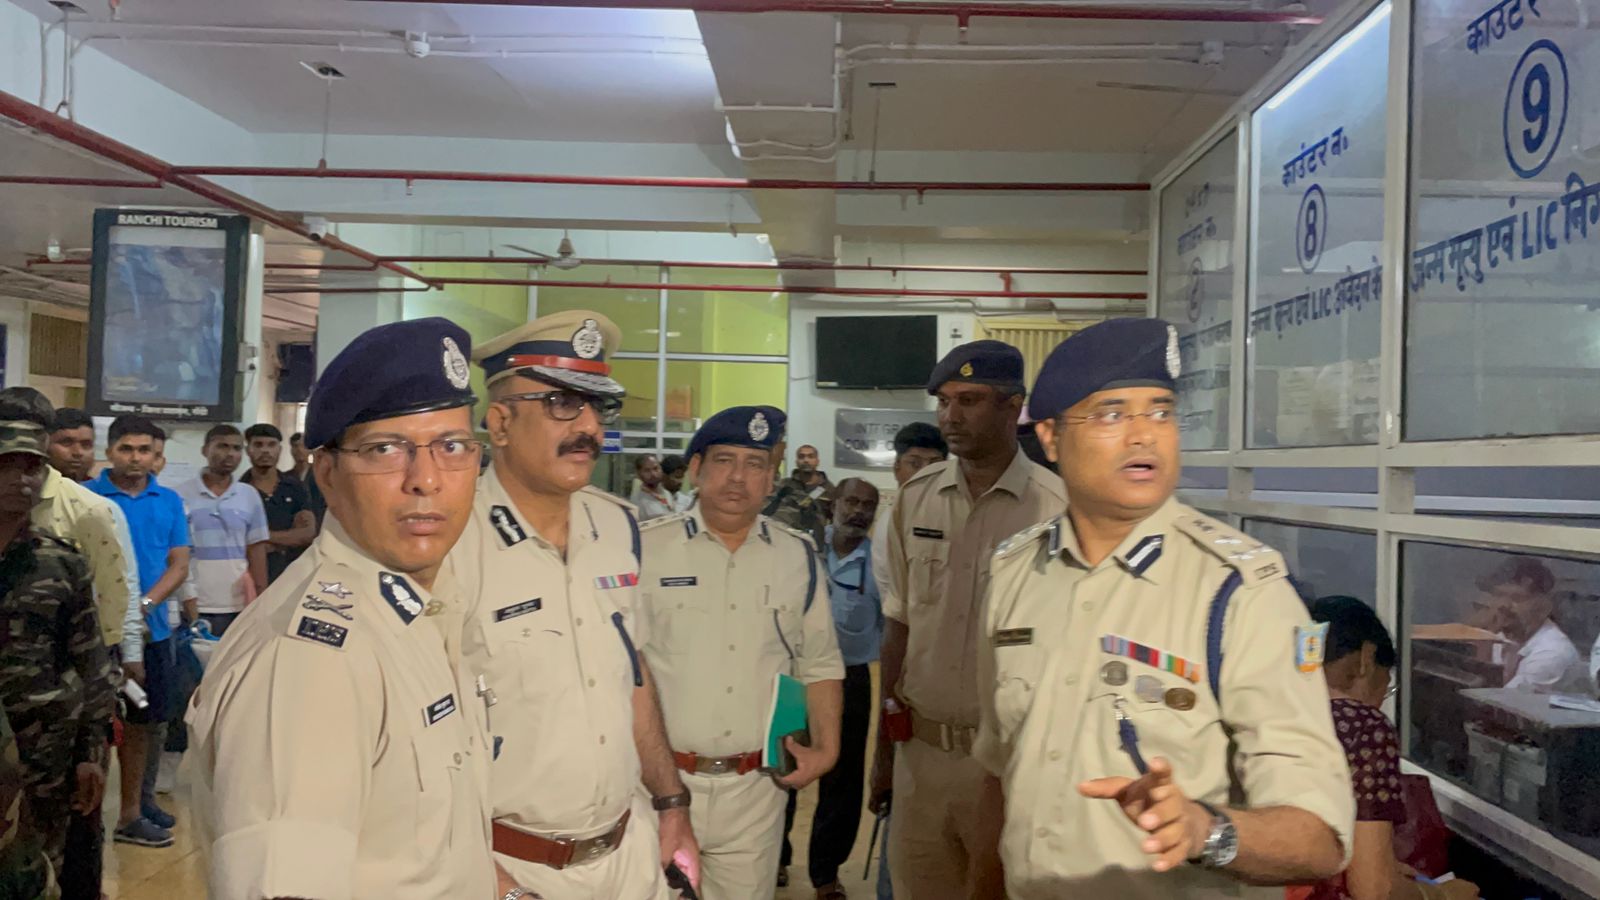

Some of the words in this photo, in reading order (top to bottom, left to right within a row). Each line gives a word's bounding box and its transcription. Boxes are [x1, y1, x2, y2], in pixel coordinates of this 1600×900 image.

[1522, 63, 1551, 154] 9
[1282, 137, 1329, 188] काउंटर
[118, 214, 163, 225] RANCHI
[164, 215, 218, 228] TOURISM
[1304, 200, 1318, 261] 8
[1486, 195, 1518, 268] एवं
[1521, 201, 1558, 259] LIC
[1311, 287, 1331, 320] LIC
